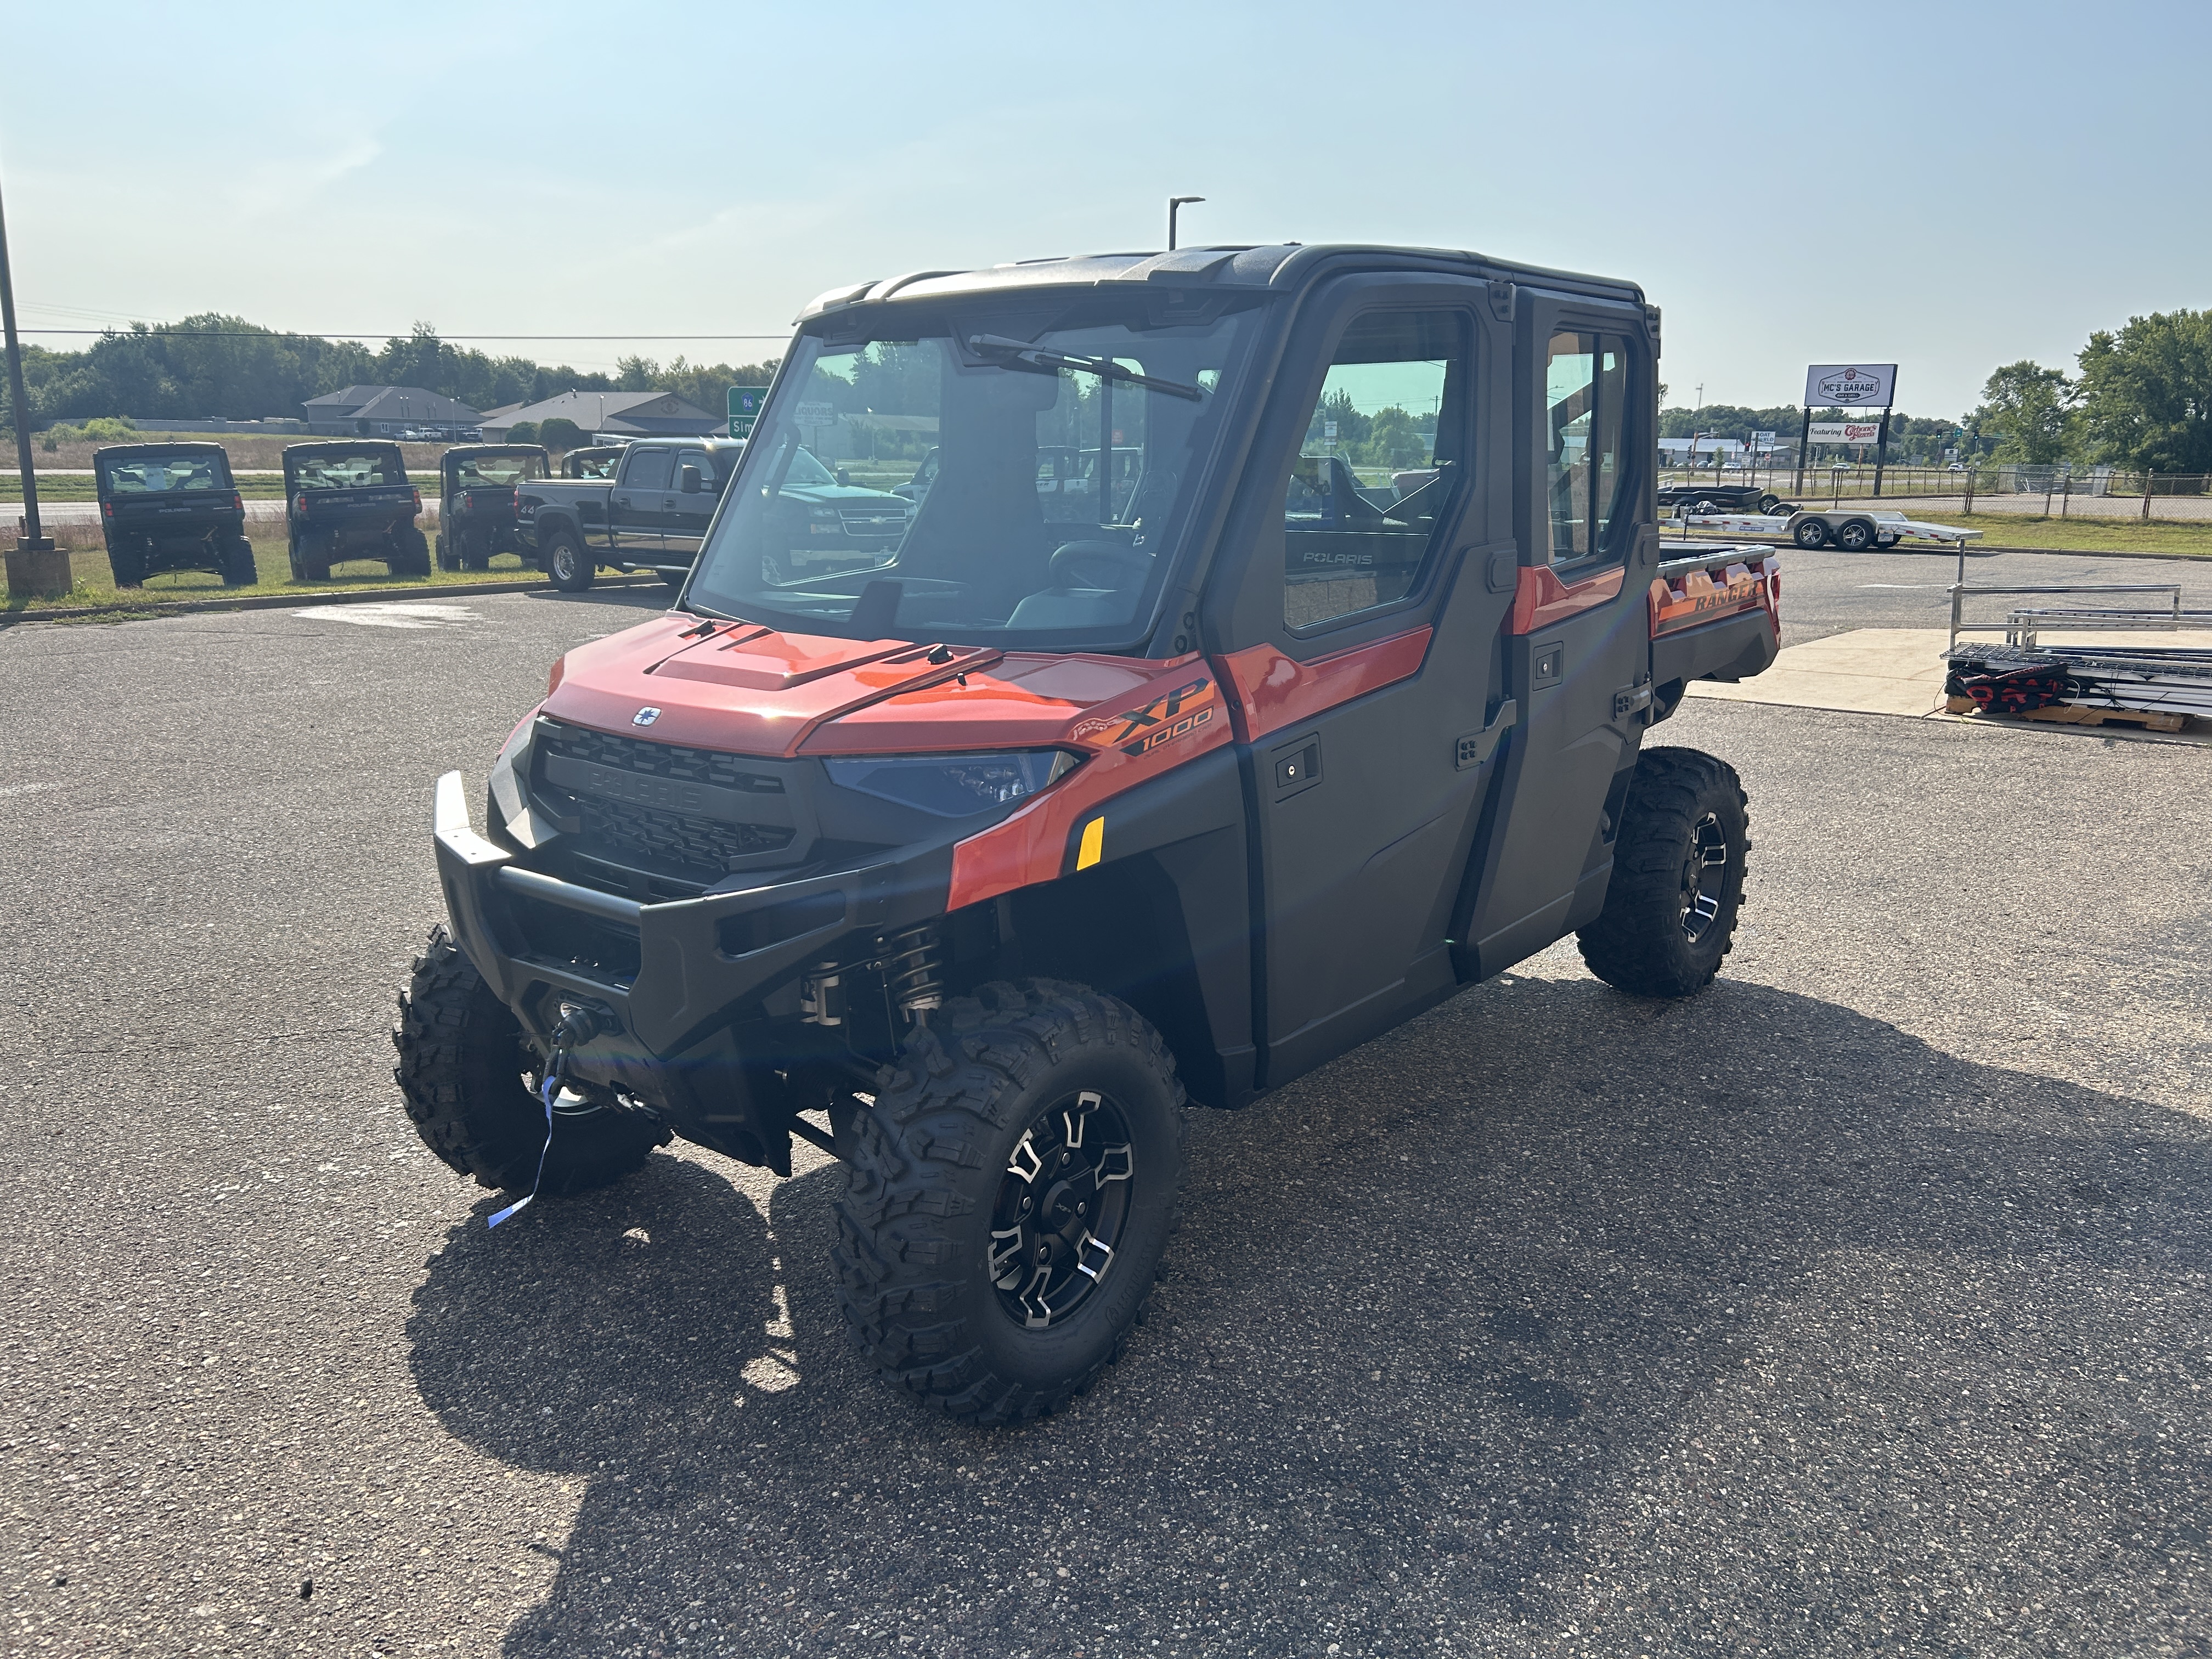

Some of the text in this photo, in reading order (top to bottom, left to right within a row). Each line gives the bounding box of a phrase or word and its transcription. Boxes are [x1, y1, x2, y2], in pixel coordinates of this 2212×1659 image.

[743, 398, 752, 408] 86
[1809, 428, 1842, 437] Featuring
[1303, 552, 1373, 565] POLARIS
[1695, 580, 1757, 612] RANGER
[1113, 677, 1210, 744] XP
[1143, 707, 1212, 752] 1000
[589, 768, 702, 810] POLARIS
[1055, 1202, 1071, 1213] XP
